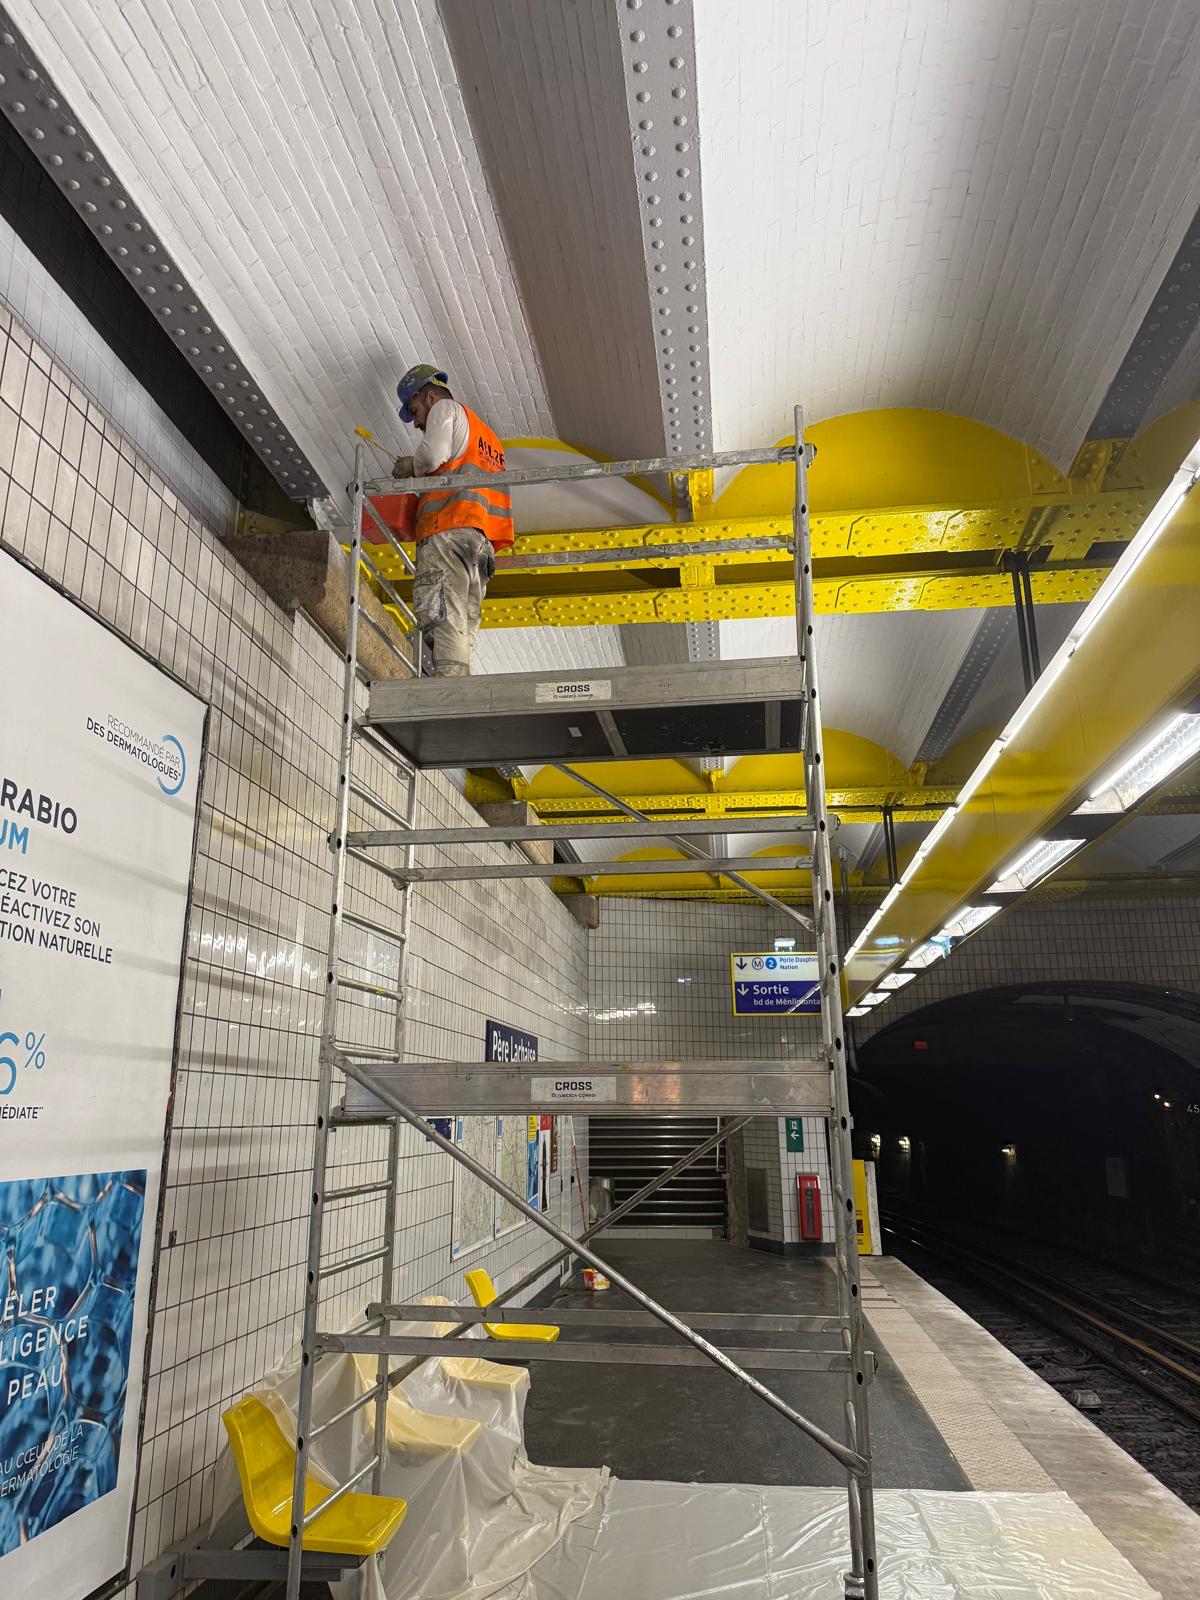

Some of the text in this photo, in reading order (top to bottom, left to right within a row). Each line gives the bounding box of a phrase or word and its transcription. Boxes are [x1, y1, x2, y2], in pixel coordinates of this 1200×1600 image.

[556, 684, 590, 693] CROSS
[86, 716, 105, 738] DES
[107, 714, 181, 768] RECOMMANDÉ PAR
[0, 777, 77, 834] RABIO
[0, 868, 77, 909] CEZ VOTRE
[0, 892, 101, 938] ÉACTIVEZ SON
[0, 920, 113, 964] TION NATURELLE
[753, 984, 789, 995] Sortie
[753, 998, 764, 1006] bd
[764, 998, 774, 1006] de
[492, 1030, 509, 1062] Père
[555, 1081, 592, 1091] CROSS
[0, 1314, 89, 1365] LIGENCE
[7, 1362, 64, 1406] PEAU
[54, 1430, 69, 1450] DE
[70, 1424, 84, 1442] LA
[0, 1445, 79, 1497] ERMATOLOGIE
